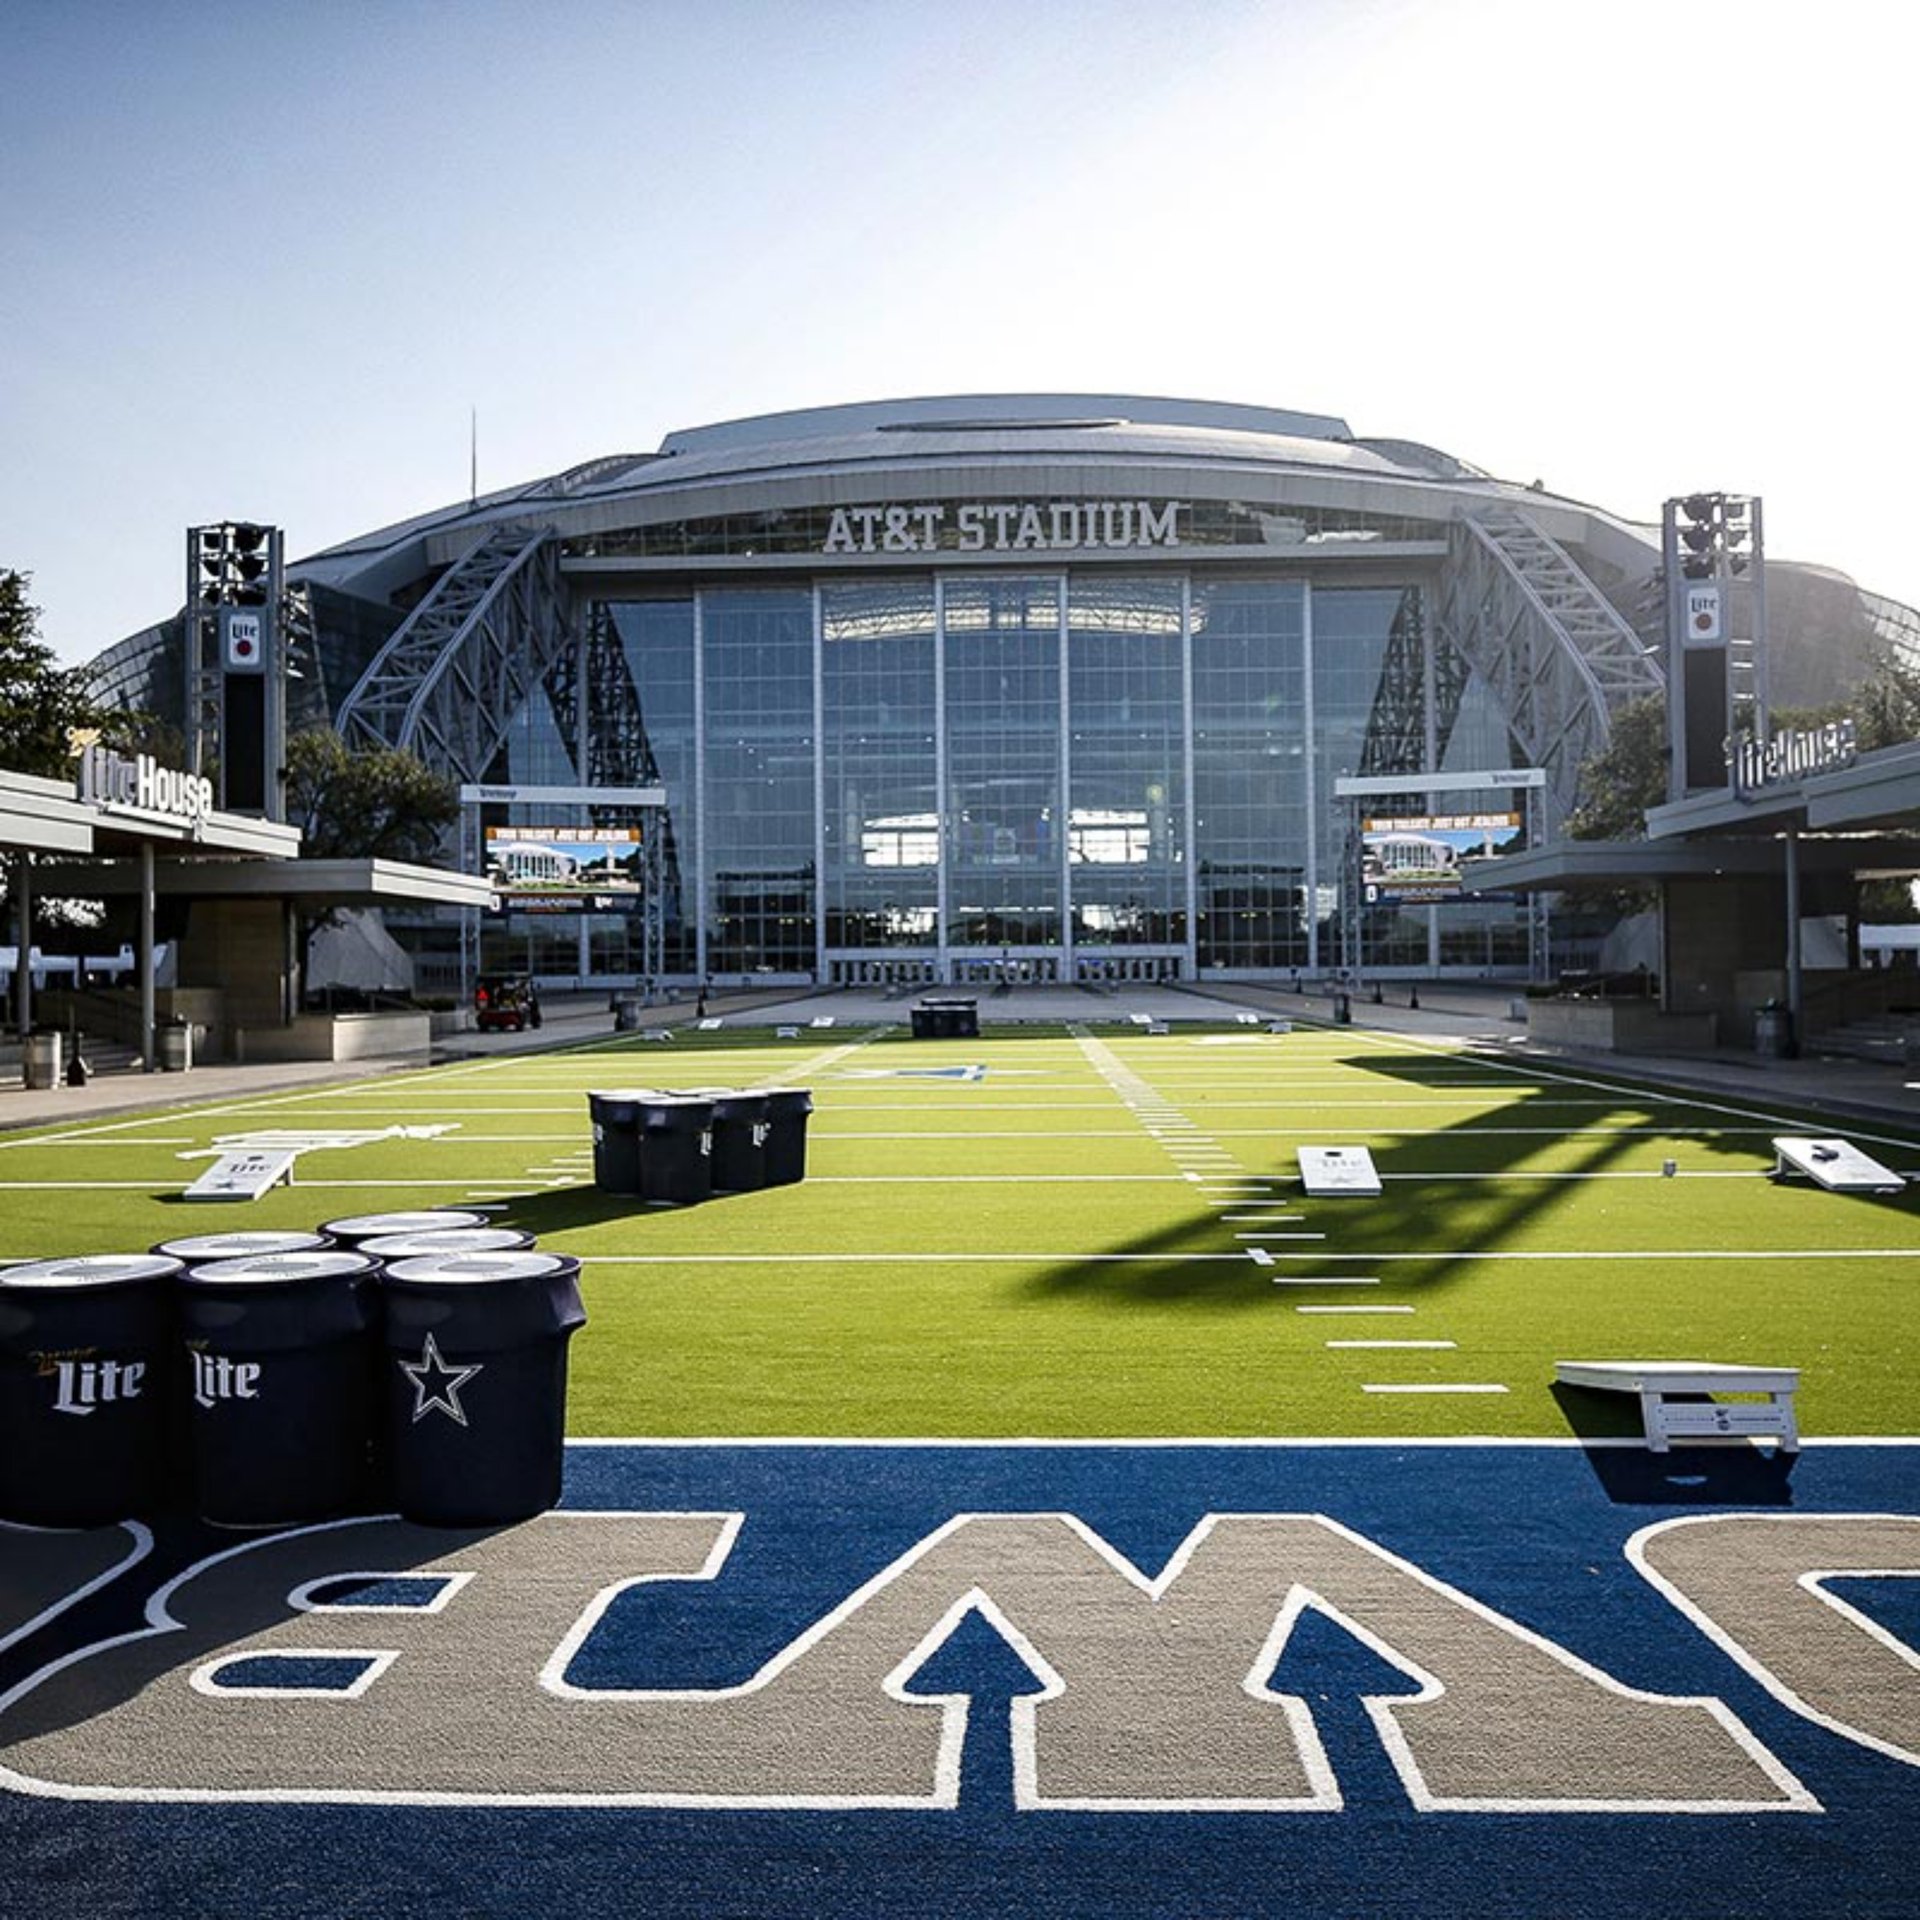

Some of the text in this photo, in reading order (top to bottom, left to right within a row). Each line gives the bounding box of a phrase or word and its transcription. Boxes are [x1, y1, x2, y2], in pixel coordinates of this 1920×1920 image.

[823, 501, 1181, 553] AT&T STADIUM
[52, 1361, 145, 1416] Lite
[192, 1350, 261, 1409] Lite
